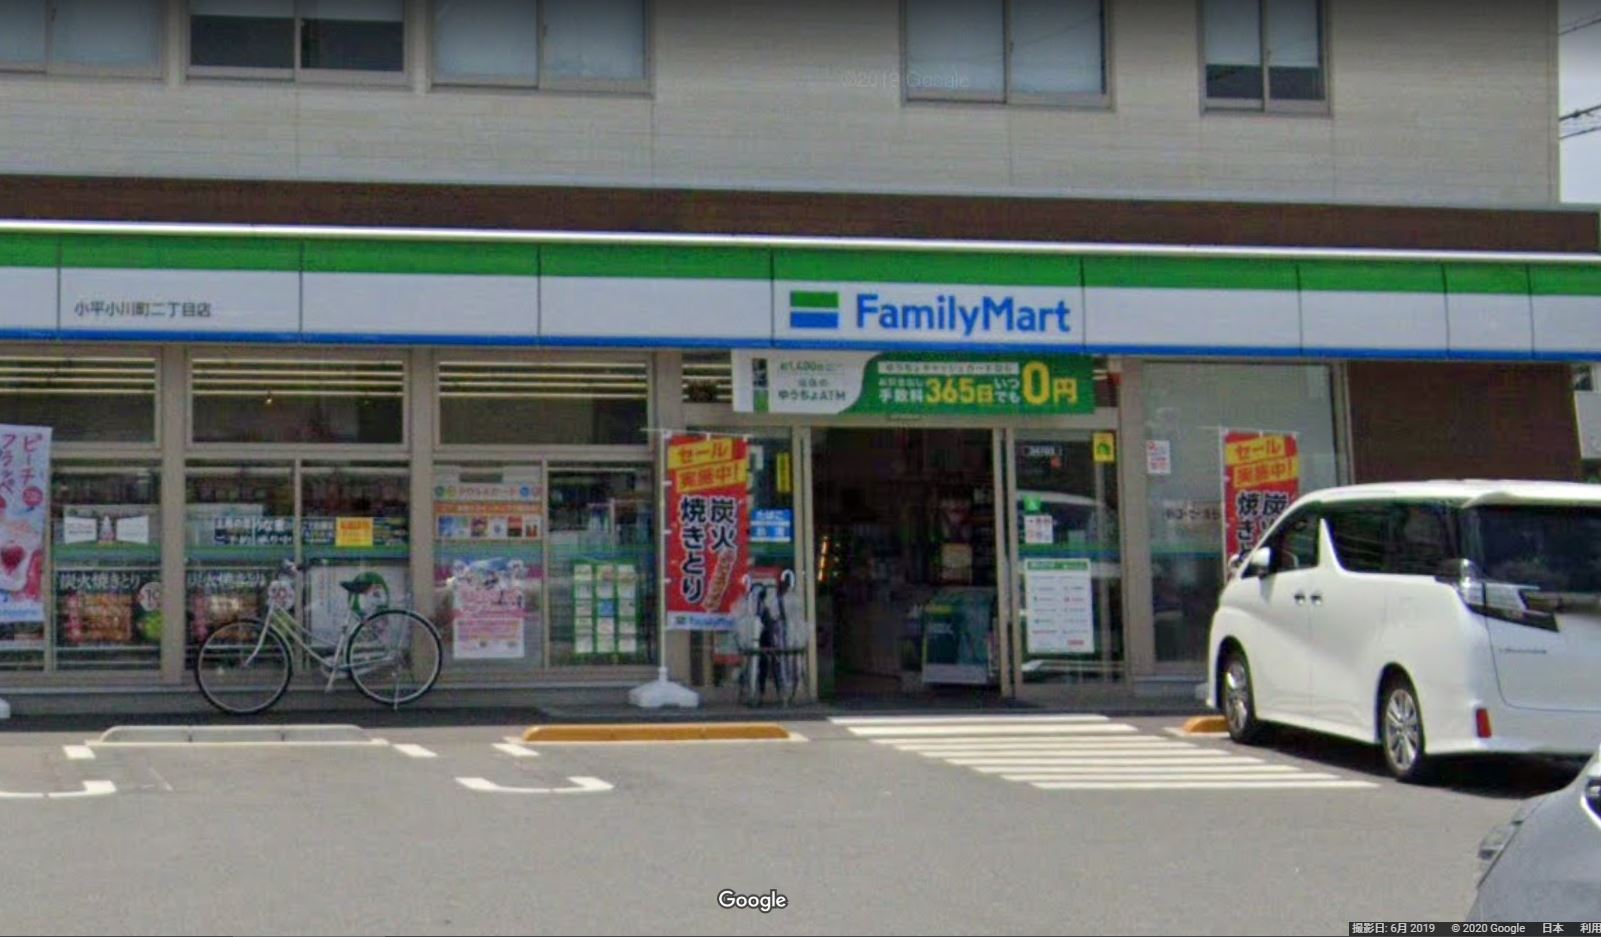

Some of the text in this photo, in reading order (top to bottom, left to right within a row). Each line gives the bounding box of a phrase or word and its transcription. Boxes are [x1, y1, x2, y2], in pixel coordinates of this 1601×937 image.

[74, 301, 211, 317] 小平小川町二丁目店
[856, 293, 1070, 336] FamilyMart
[22, 433, 43, 486] ピーチ
[677, 437, 726, 464] セール
[708, 498, 738, 552] 炭火
[681, 497, 707, 603] 焼きとり
